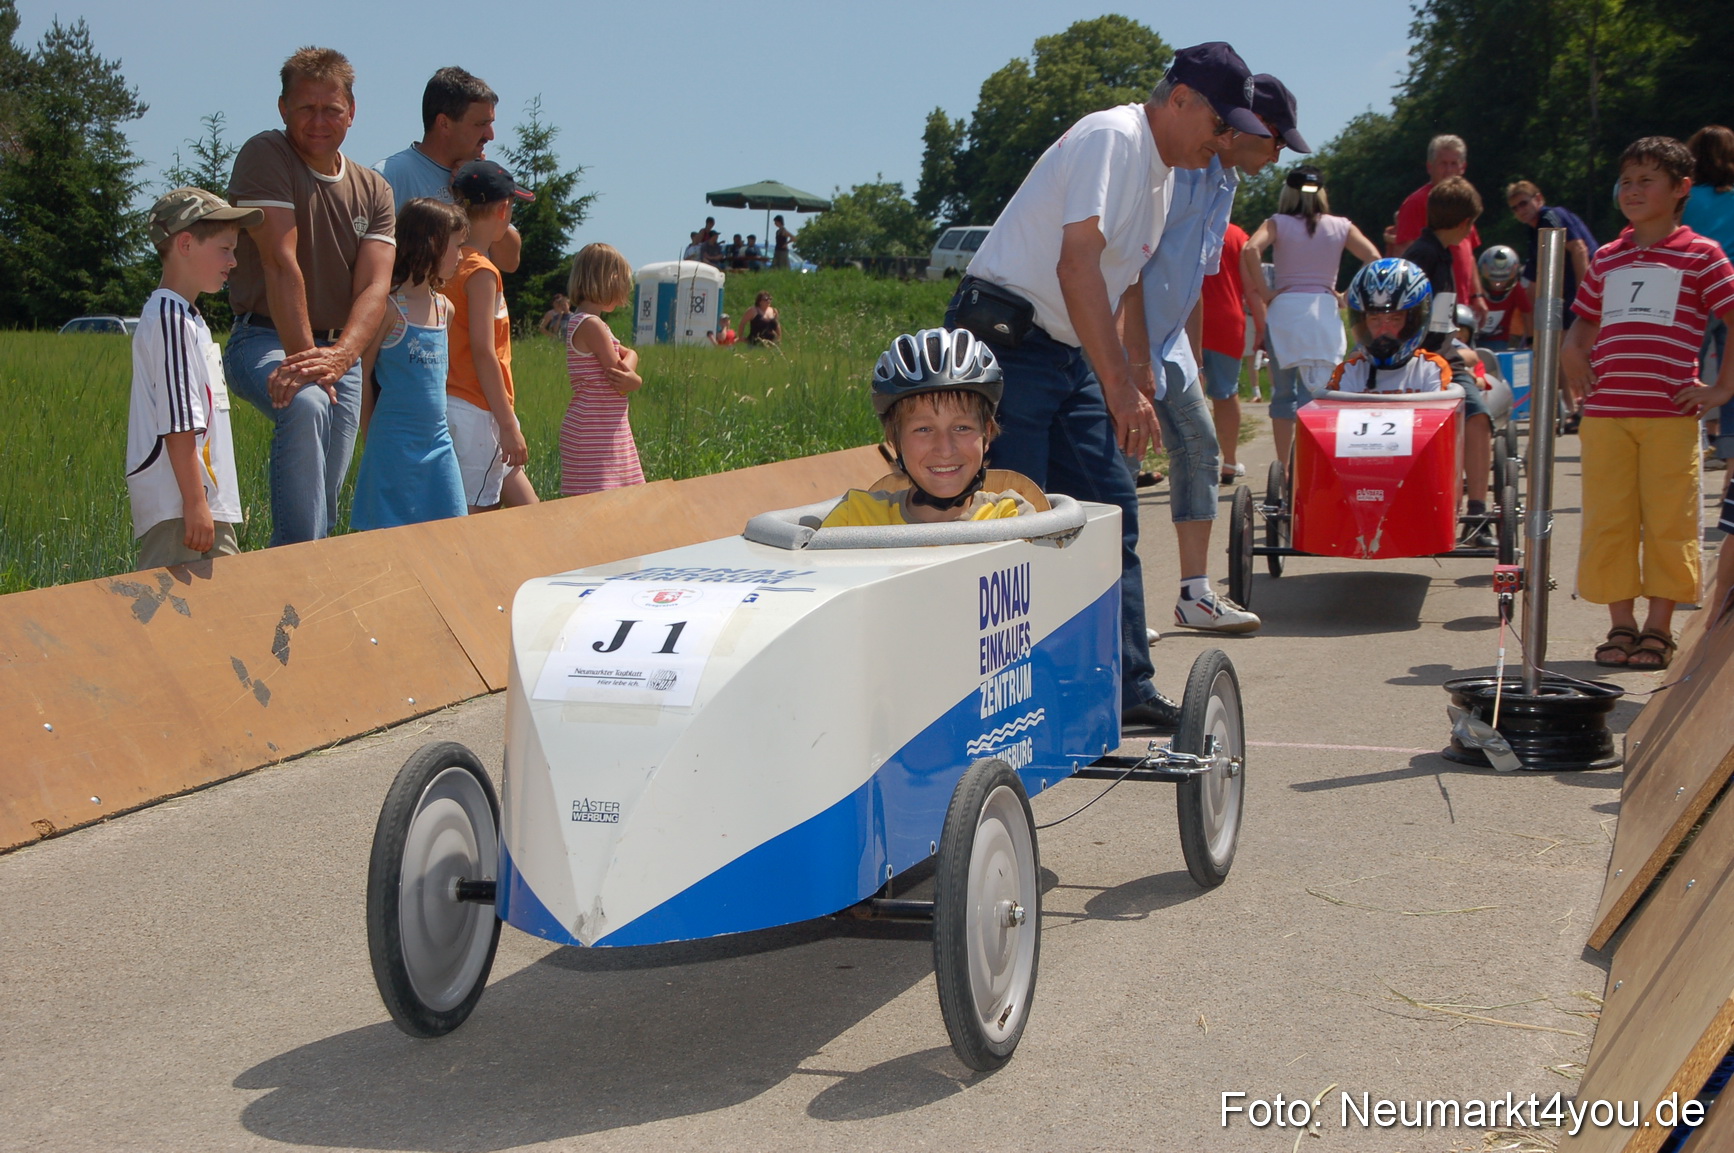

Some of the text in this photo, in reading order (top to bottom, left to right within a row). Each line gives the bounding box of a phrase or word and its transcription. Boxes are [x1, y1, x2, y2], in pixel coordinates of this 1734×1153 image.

[1630, 281, 1644, 303] 7
[1353, 422, 1397, 436] J 2
[980, 562, 1030, 631] DONAU
[592, 619, 687, 654] J 1
[979, 621, 1032, 676] EINKAUFS
[574, 668, 643, 677] Neumarkter Tagblatt
[980, 662, 1032, 720] ZENTRUM
[572, 797, 620, 812] RASTER
[572, 811, 619, 823] WERBUNG
